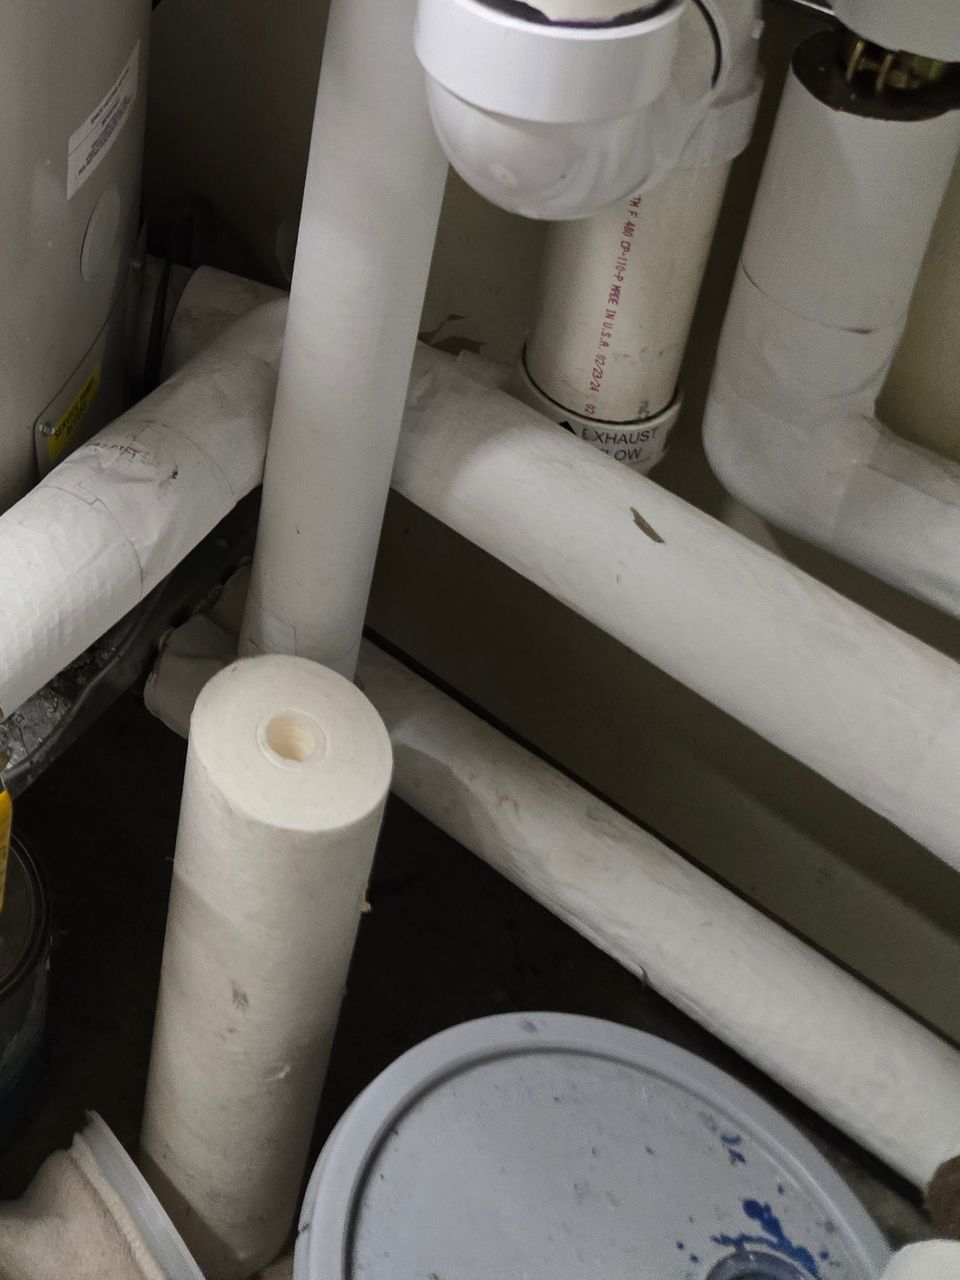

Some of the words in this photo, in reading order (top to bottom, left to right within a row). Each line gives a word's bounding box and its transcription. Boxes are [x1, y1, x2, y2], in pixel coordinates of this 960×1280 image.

[627, 209, 638, 217] F
[603, 308, 616, 319] IN
[582, 426, 658, 445] EXHAUST
